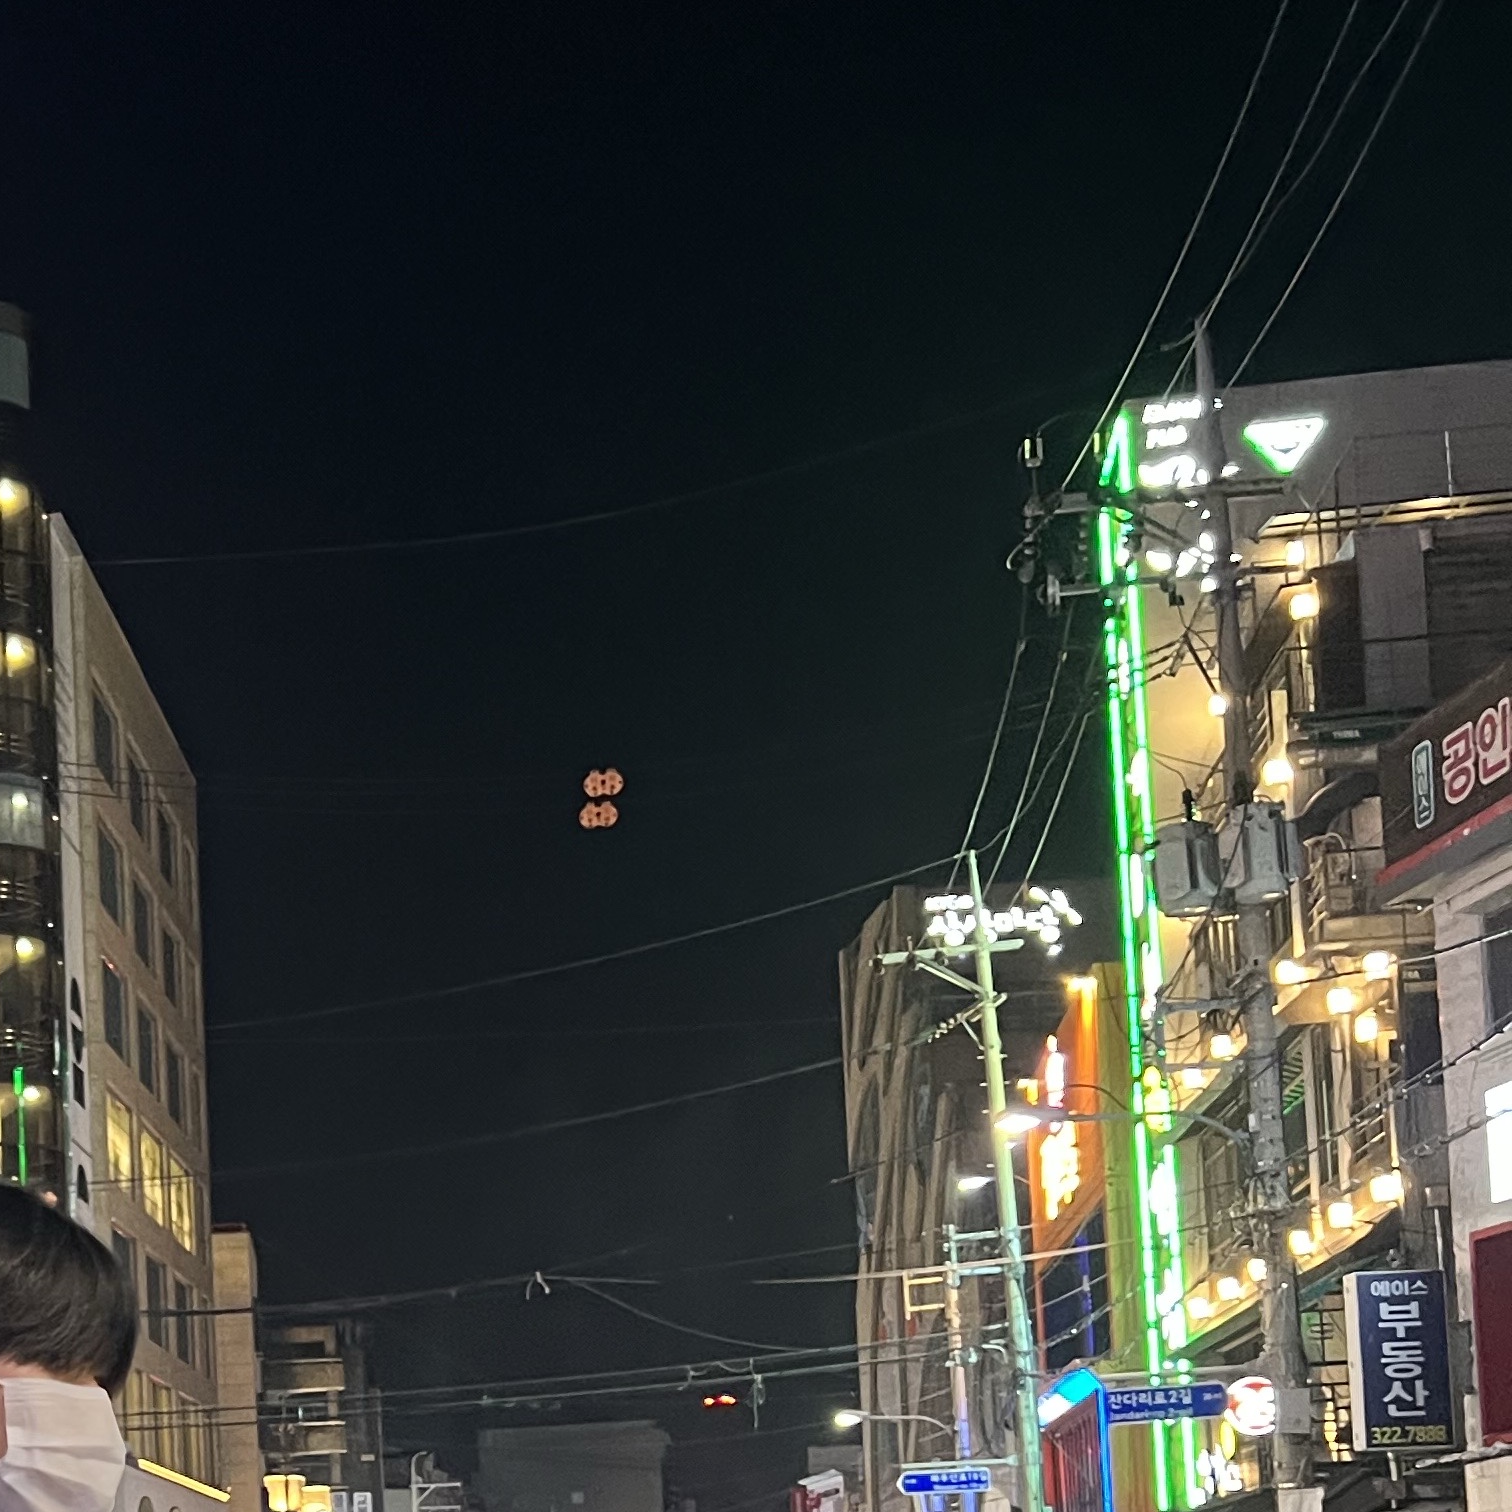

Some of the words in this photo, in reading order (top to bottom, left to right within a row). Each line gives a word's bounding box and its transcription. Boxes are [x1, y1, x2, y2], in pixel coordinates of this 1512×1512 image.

[1442, 697, 1511, 804] 공인
[1370, 1279, 1429, 1297] 에이스
[1377, 1300, 1431, 1418] 부동산
